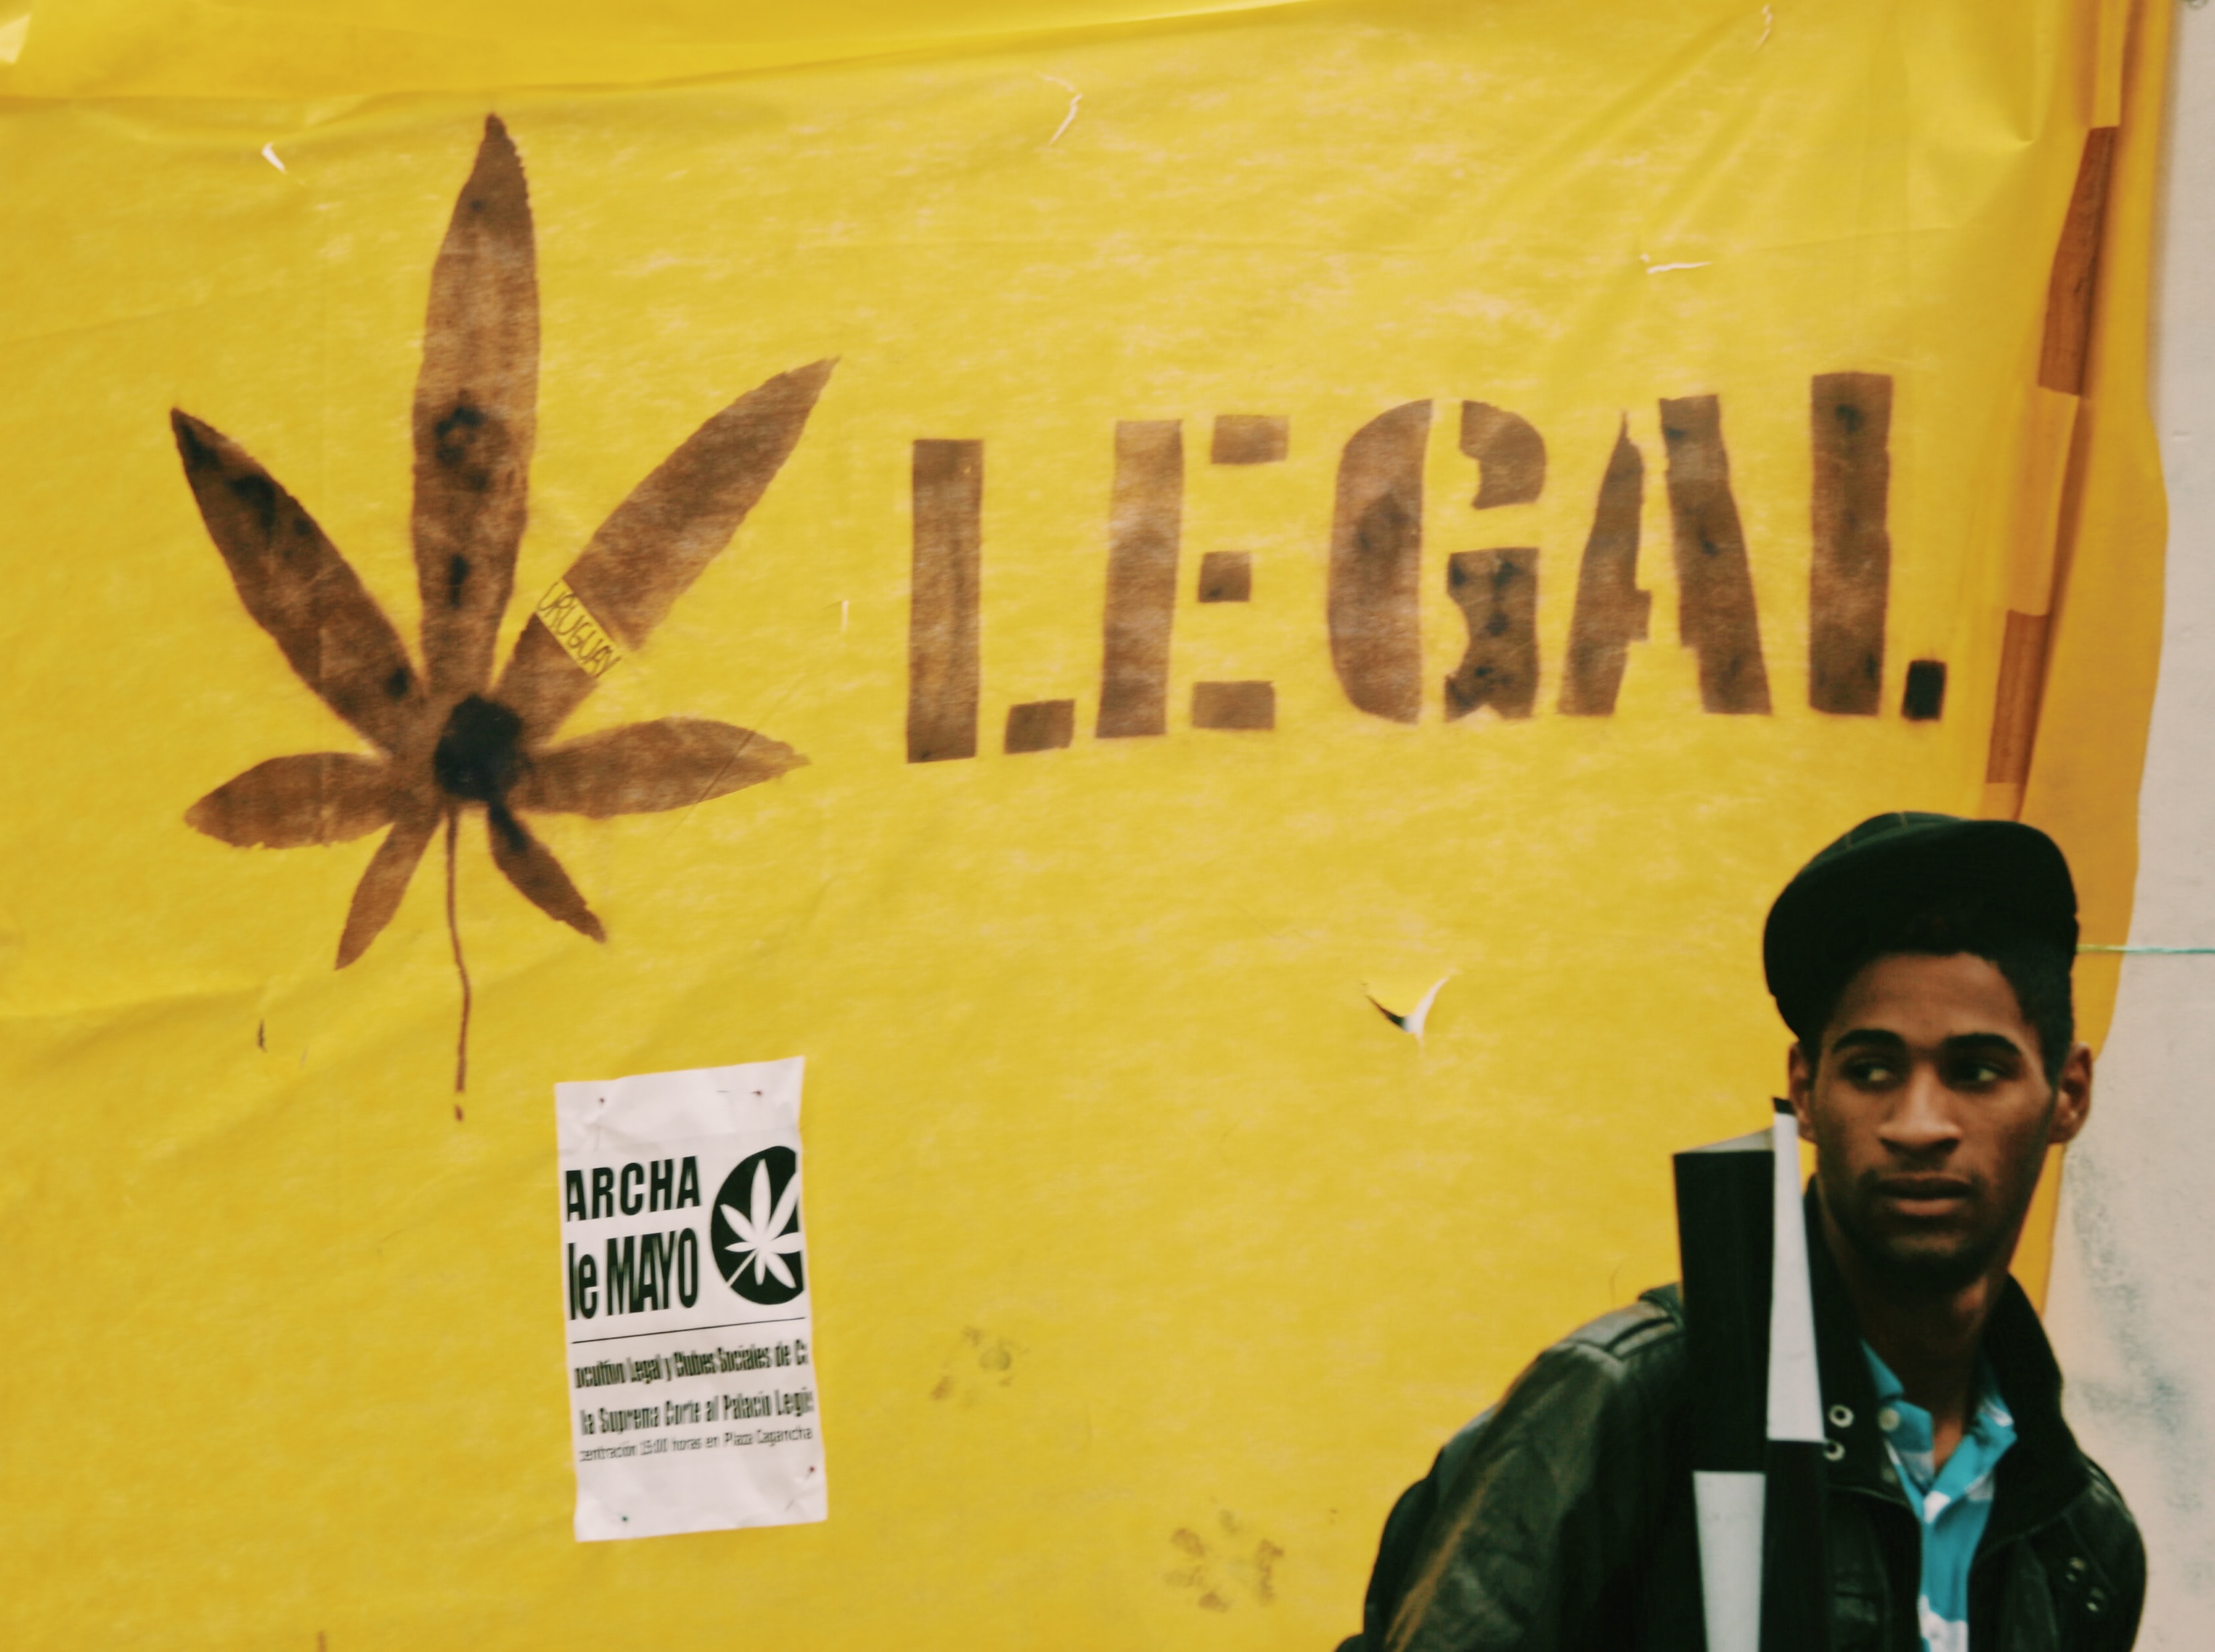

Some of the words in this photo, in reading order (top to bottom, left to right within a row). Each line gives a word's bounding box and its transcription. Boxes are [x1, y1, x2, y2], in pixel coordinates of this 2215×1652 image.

[906, 372, 1948, 763] LEGAL
[537, 577, 622, 679] URUGUAY
[565, 1156, 700, 1222] ARCHA
[606, 1227, 699, 1316] MAYO
[626, 1354, 662, 1384] Legal
[664, 1357, 671, 1381] y
[674, 1350, 716, 1377] Clubes
[717, 1344, 770, 1373] Sociales
[775, 1341, 791, 1367] de
[580, 1410, 595, 1435] la
[599, 1406, 659, 1434] Suprema
[664, 1400, 700, 1426] Corte
[706, 1395, 719, 1422] al
[723, 1391, 772, 1420] Palacio
[672, 1436, 701, 1451] horas
[706, 1436, 719, 1448] en
[724, 1431, 753, 1446] Plaza
[756, 1426, 813, 1447] Cagancha
